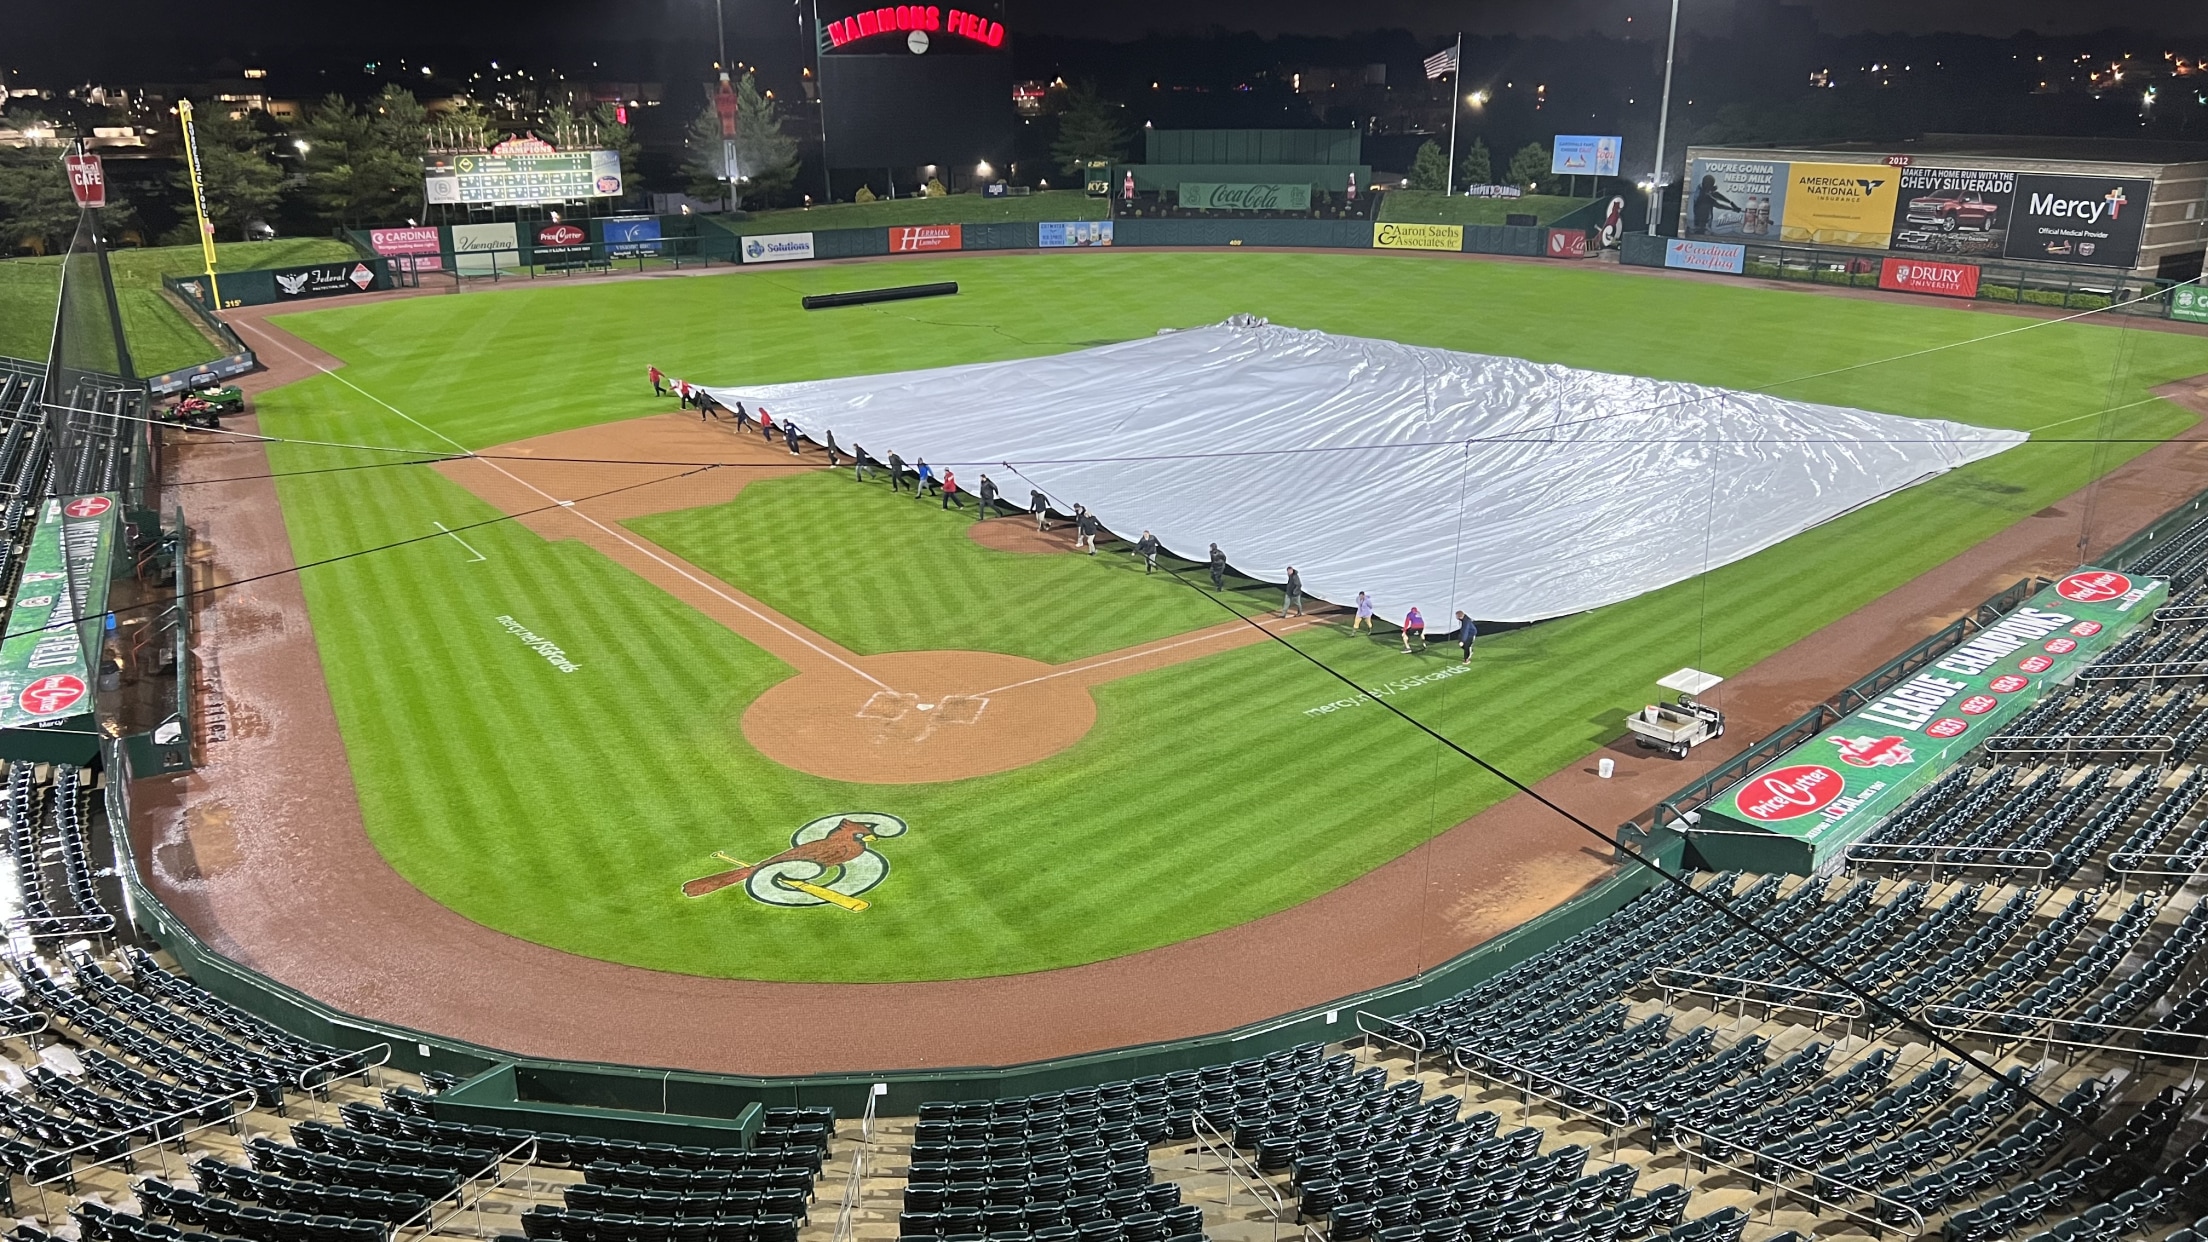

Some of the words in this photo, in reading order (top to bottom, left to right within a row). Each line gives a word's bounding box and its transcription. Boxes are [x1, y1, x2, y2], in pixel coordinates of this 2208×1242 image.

[827, 5, 939, 47] HAMMONS
[947, 9, 1004, 47] FIELD
[1705, 162, 1738, 173] YOU'RE
[1739, 164, 1774, 174] GONNA
[1888, 157, 1908, 165] 2012
[75, 173, 102, 185] CAFE
[1724, 173, 1747, 183] NEED
[1748, 174, 1773, 184] MILK
[1799, 177, 1854, 187] AMERICAN
[1902, 169, 1923, 177] MAKE
[1938, 170, 1960, 178] HOME
[1961, 171, 1976, 179] RUN
[1978, 172, 1998, 180] WITH
[1999, 173, 2014, 181] THE
[1726, 184, 1745, 193] FOR
[1746, 185, 1772, 194] THAT.
[1807, 186, 1860, 197] NATIONAL
[1901, 177, 1941, 189] CHEVY
[1943, 178, 2013, 193] SILVERADO
[1210, 184, 1280, 208] Coca-Cola
[1817, 195, 1860, 203] INSURANCE
[2029, 192, 2106, 224] Mercy
[386, 230, 438, 241] CARDINAL
[1393, 225, 1425, 236] Aaron
[1428, 226, 1459, 238] Sachs
[2038, 227, 2059, 235] Official
[2060, 229, 2083, 237] Medical
[2084, 230, 2109, 239] Provider
[457, 235, 515, 250] Yuengling
[768, 241, 810, 252] Solutions
[919, 239, 942, 247] Lumber
[1395, 236, 1445, 247] Associates
[1684, 243, 1739, 258] Cardinal
[1684, 255, 1734, 270] Roofing
[311, 267, 346, 284] Federal
[1911, 266, 1963, 283] DRURY
[1910, 280, 1961, 290] UNIVERSITY
[2069, 621, 2099, 636] 2012
[1935, 607, 2076, 676] CHAMPIONS
[27, 633, 80, 669] FIELD
[2021, 655, 2052, 673] 1937
[1303, 664, 1471, 718] mercy.net/SGFcards
[1992, 675, 2027, 693] 1934
[1857, 673, 1968, 732] LEAGUE
[1961, 695, 1994, 715] 1932
[39, 719, 64, 729] Mercy
[1929, 717, 1967, 739] 1931
[1820, 796, 1865, 821] LOCAL
